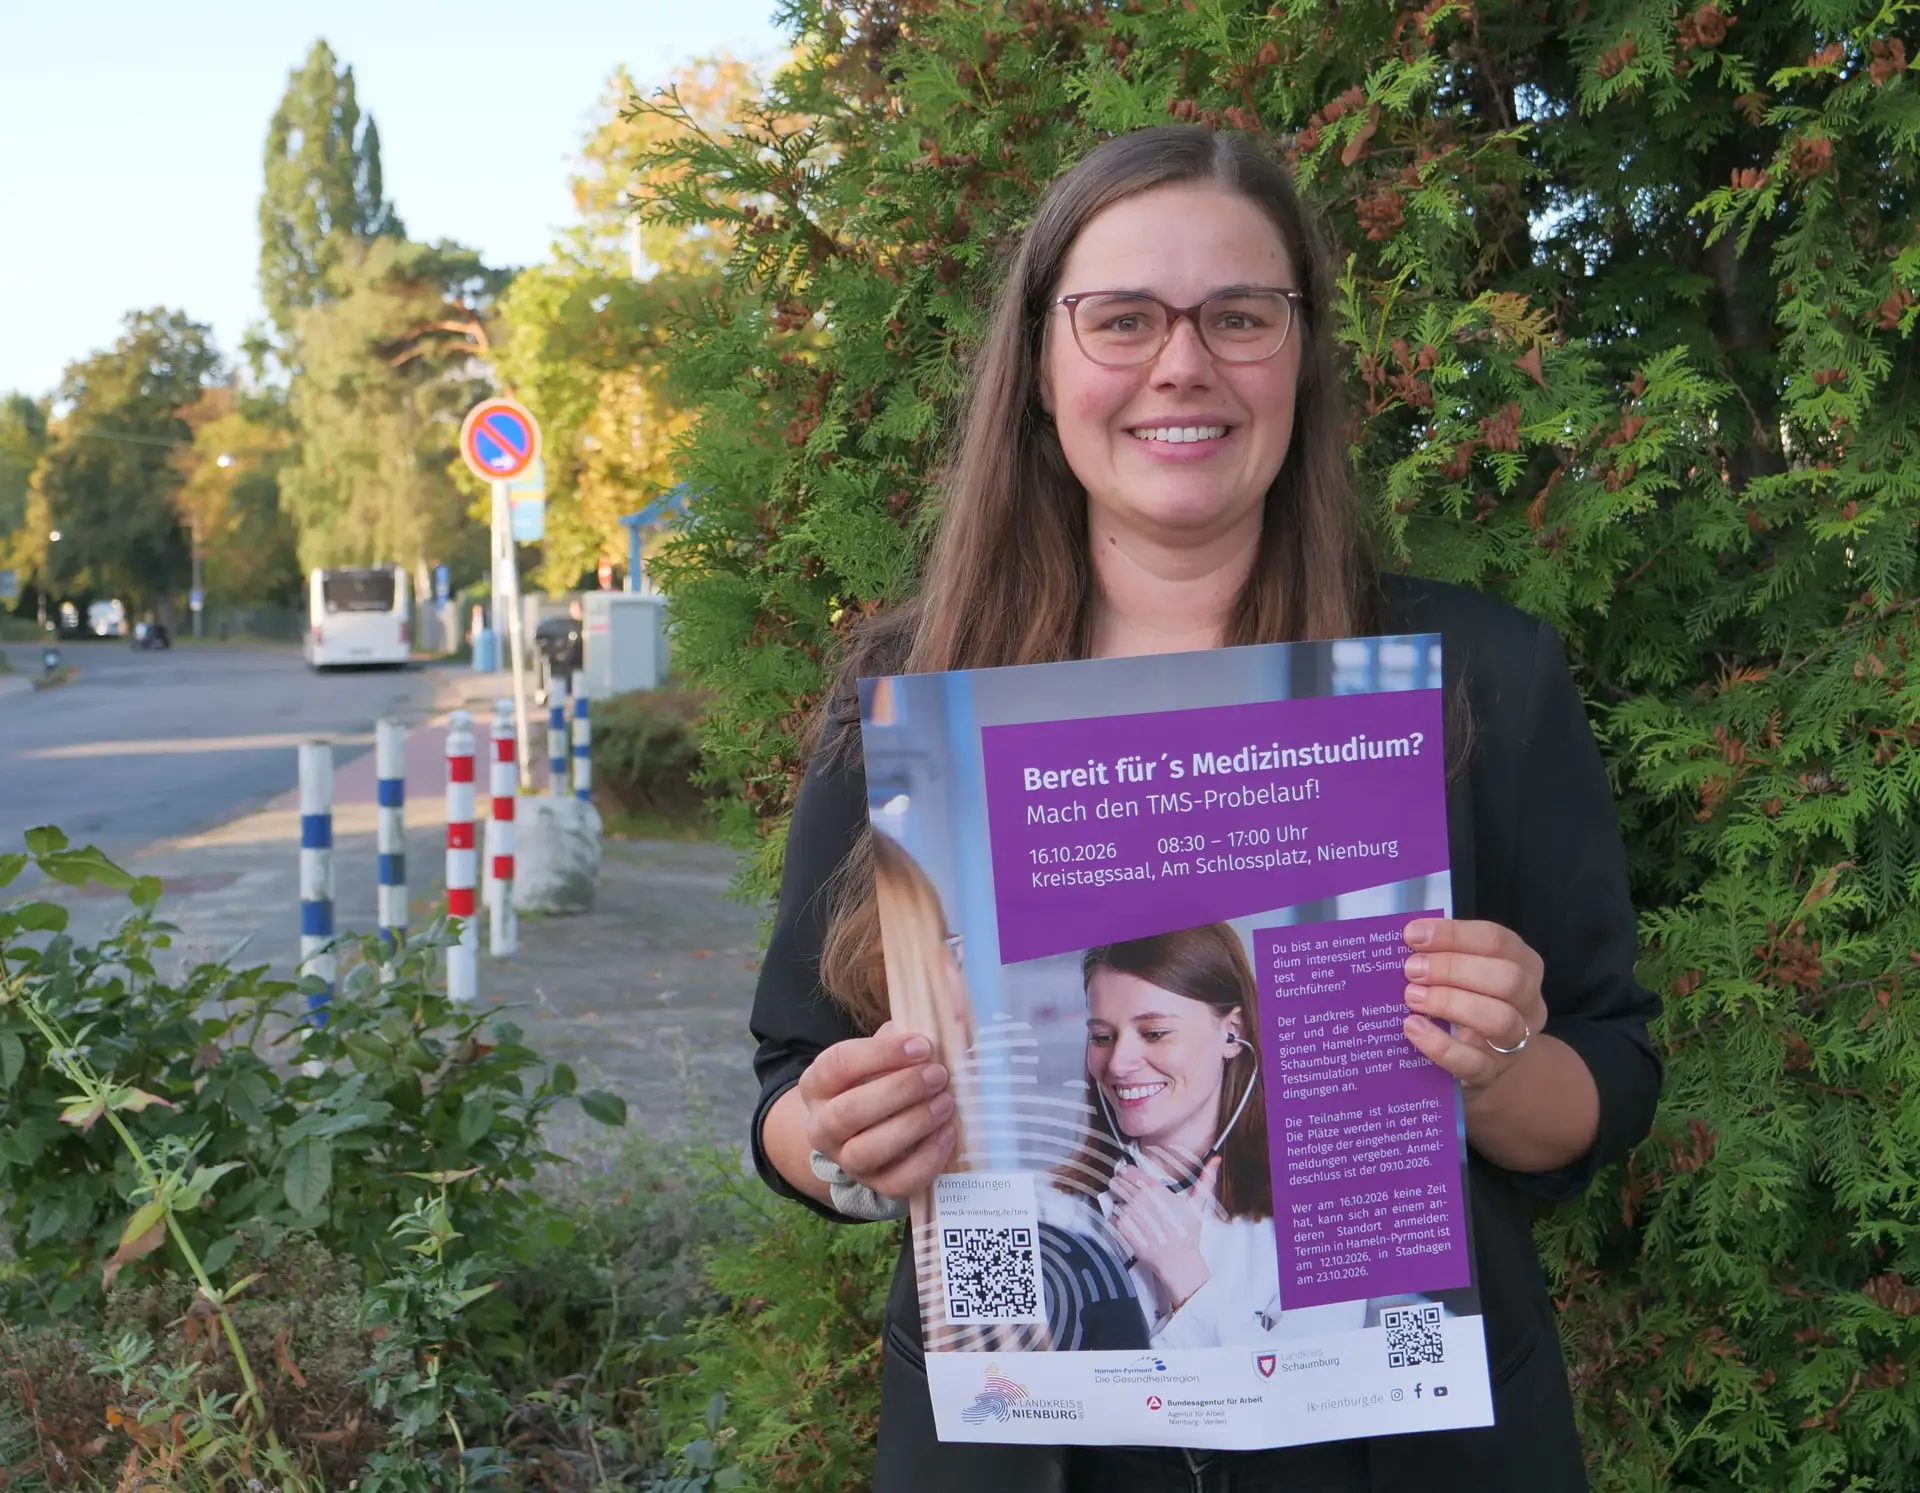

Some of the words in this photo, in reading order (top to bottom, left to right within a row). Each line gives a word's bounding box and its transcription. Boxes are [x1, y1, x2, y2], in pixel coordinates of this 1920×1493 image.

[1024, 759, 1109, 791] Bereit
[1193, 732, 1423, 776] Medizinstudium?
[1027, 800, 1086, 825] Mach
[1096, 797, 1138, 819] den
[1146, 778, 1319, 814] TMS-Probelauf!
[1030, 842, 1116, 864] 16.10.2026
[1157, 834, 1204, 854] 08:30
[1227, 828, 1270, 847] 17:00
[1277, 824, 1308, 842] Uhr
[1032, 861, 1155, 888] Kreistagssaal,
[1161, 861, 1189, 877] Am
[1196, 849, 1311, 874] Schlossplatz,
[1317, 840, 1398, 861] Nienburg
[1273, 944, 1286, 954] Du
[1292, 941, 1311, 952] bist
[1315, 941, 1328, 950] an
[1333, 936, 1365, 948] einem
[1370, 929, 1404, 943] Medizi
[1274, 958, 1300, 969] dium
[1307, 950, 1366, 965] interessiert
[1372, 945, 1392, 957] und
[1275, 972, 1295, 983] test
[1312, 968, 1334, 979] eine
[1350, 957, 1405, 974] TMS-Simul
[1276, 980, 1346, 998] durchführen?
[1278, 1017, 1296, 1027] Der
[1304, 1009, 1354, 1024] Landkreis
[1362, 1003, 1410, 1016] Nienburg
[1279, 1032, 1295, 1041] ser
[1304, 1026, 1324, 1038] und
[1333, 1024, 1348, 1035] die
[1357, 1017, 1407, 1032] Gesundh
[1280, 1044, 1316, 1058] gionen
[1323, 1033, 1406, 1050] Hameln-Pyrmon
[1281, 1053, 1347, 1070] Schaumburg
[1351, 1050, 1383, 1061] bieten
[1387, 1046, 1408, 1056] eine
[1281, 1067, 1358, 1085] Testsimulation
[1365, 1063, 1392, 1074] unter
[1399, 1056, 1434, 1069] Realbe
[1283, 1085, 1339, 1100] dingungen
[1342, 1082, 1358, 1092] an.
[1285, 1117, 1302, 1128] Die
[1308, 1110, 1363, 1124] Teilnahme
[1369, 1106, 1382, 1116] ist
[1388, 1097, 1441, 1114] kostenfrei.
[1287, 1131, 1303, 1142] Die
[1308, 1127, 1339, 1139] Plätze
[1343, 1122, 1381, 1134] werden
[1386, 1119, 1395, 1128] in
[1400, 1116, 1417, 1126] der
[1422, 1112, 1441, 1123] Rei-
[1288, 1141, 1335, 1156] henfolge
[1336, 1139, 1353, 1149] der
[1355, 1130, 1422, 1147] eingehenden
[1425, 1128, 1443, 1138] An-
[1289, 1156, 1347, 1171] meldungen
[1352, 1148, 1402, 1162] vergeben.
[1407, 1140, 1443, 1154] Anmel-
[1290, 1171, 1341, 1185] deschluss
[1345, 1168, 1356, 1177] ist
[1360, 1164, 1377, 1176] der
[1380, 1157, 1432, 1173] 09.10.2026.
[938, 1180, 1011, 1191] Anmeldungen
[939, 1194, 970, 1203] unter:
[1292, 1204, 1312, 1214] Wer
[1318, 1201, 1334, 1210] am
[1340, 1191, 1388, 1206] 16.10.2026
[1394, 1188, 1422, 1199] keine
[1427, 1183, 1446, 1195] Zeit
[939, 1208, 1028, 1217] www.lk-nienburg.de/tms
[1293, 1217, 1313, 1228] hat,
[1319, 1214, 1343, 1224] kann
[1349, 1208, 1369, 1220] sich
[1374, 1208, 1387, 1216] an
[1392, 1202, 1424, 1214] einem
[1430, 1200, 1447, 1209] an-
[1294, 1231, 1324, 1242] deren
[1337, 1222, 1382, 1236] Standort
[1394, 1213, 1448, 1228] anmelden:
[1295, 1243, 1331, 1256] Termin
[1334, 1241, 1343, 1251] in
[1346, 1230, 1435, 1249] Hameln-Pyrmont
[1438, 1227, 1450, 1237] ist
[1296, 1261, 1312, 1271] am
[1320, 1252, 1371, 1267] 12.10.2026,
[1379, 1249, 1388, 1259] in
[1396, 1242, 1451, 1257] Stadhagen
[1297, 1276, 1313, 1285] am
[1317, 1266, 1368, 1283] 23.10.2026.
[1281, 1357, 1340, 1372] Schaumburg
[1112, 1374, 1200, 1384] Gesundheitsregion
[1019, 1400, 1076, 1409] LANDKREIS
[1167, 1399, 1225, 1407] Bundesagentur
[1227, 1397, 1238, 1405] für
[1239, 1396, 1263, 1404] Arbeit
[1307, 1393, 1384, 1412] lk-nienburg.de
[1012, 1409, 1077, 1420] NIENBURG
